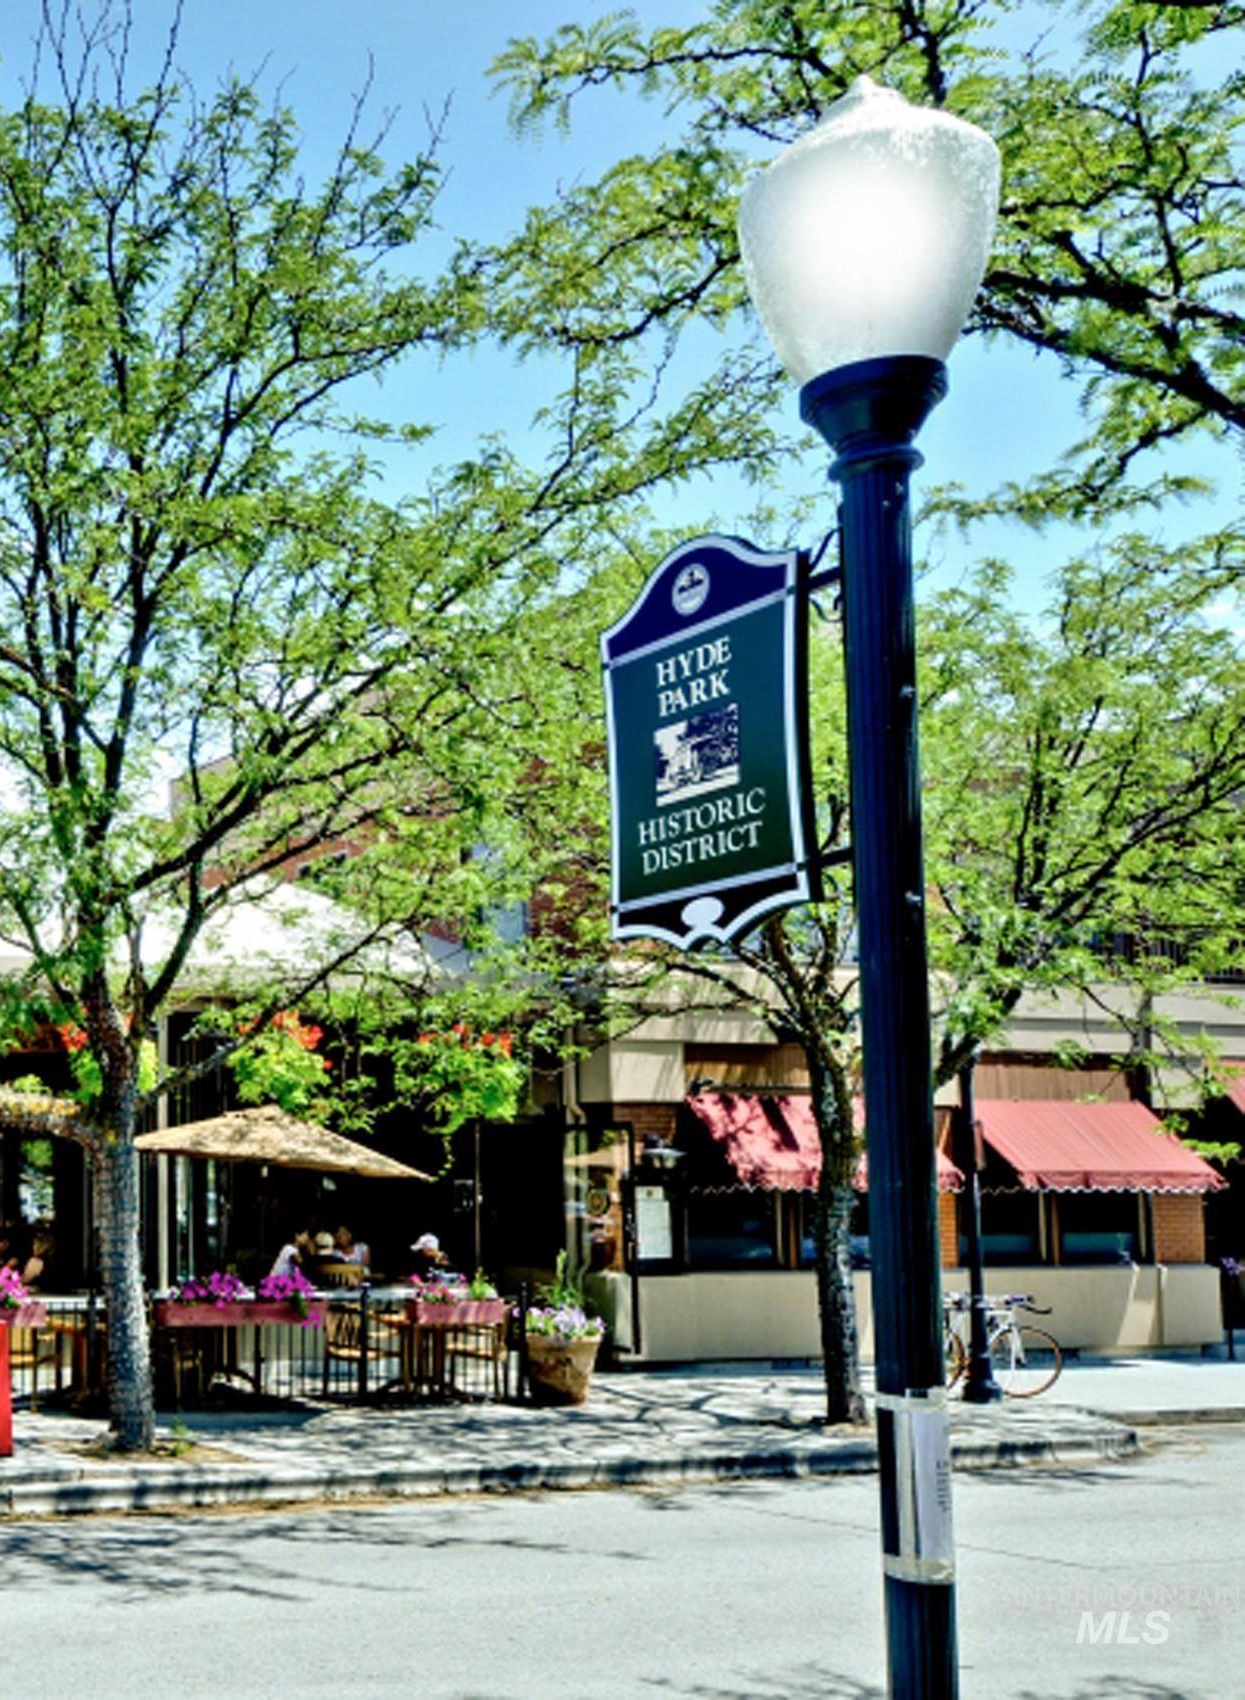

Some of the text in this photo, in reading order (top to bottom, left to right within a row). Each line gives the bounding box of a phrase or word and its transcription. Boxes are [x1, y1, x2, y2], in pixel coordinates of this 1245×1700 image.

[656, 636, 733, 688] HYDE
[657, 668, 730, 718] PARK
[638, 787, 766, 847] HISTORIC
[642, 820, 763, 876] DISTRICT
